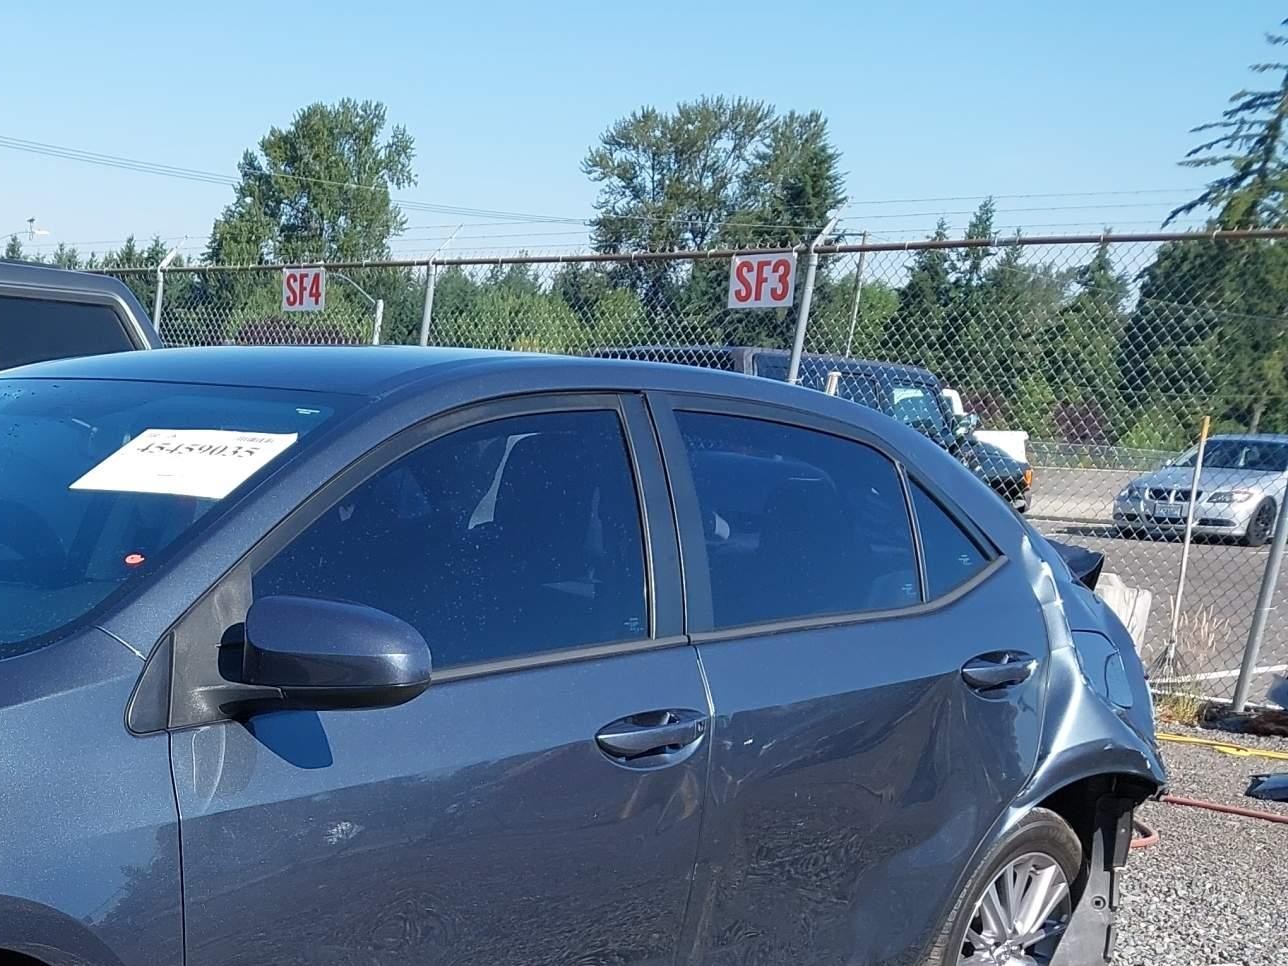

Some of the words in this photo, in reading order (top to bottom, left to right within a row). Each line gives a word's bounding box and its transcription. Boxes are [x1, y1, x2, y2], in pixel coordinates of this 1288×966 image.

[286, 272, 321, 306] SF4
[734, 259, 791, 302] SF3
[137, 442, 260, 458] 45459035
